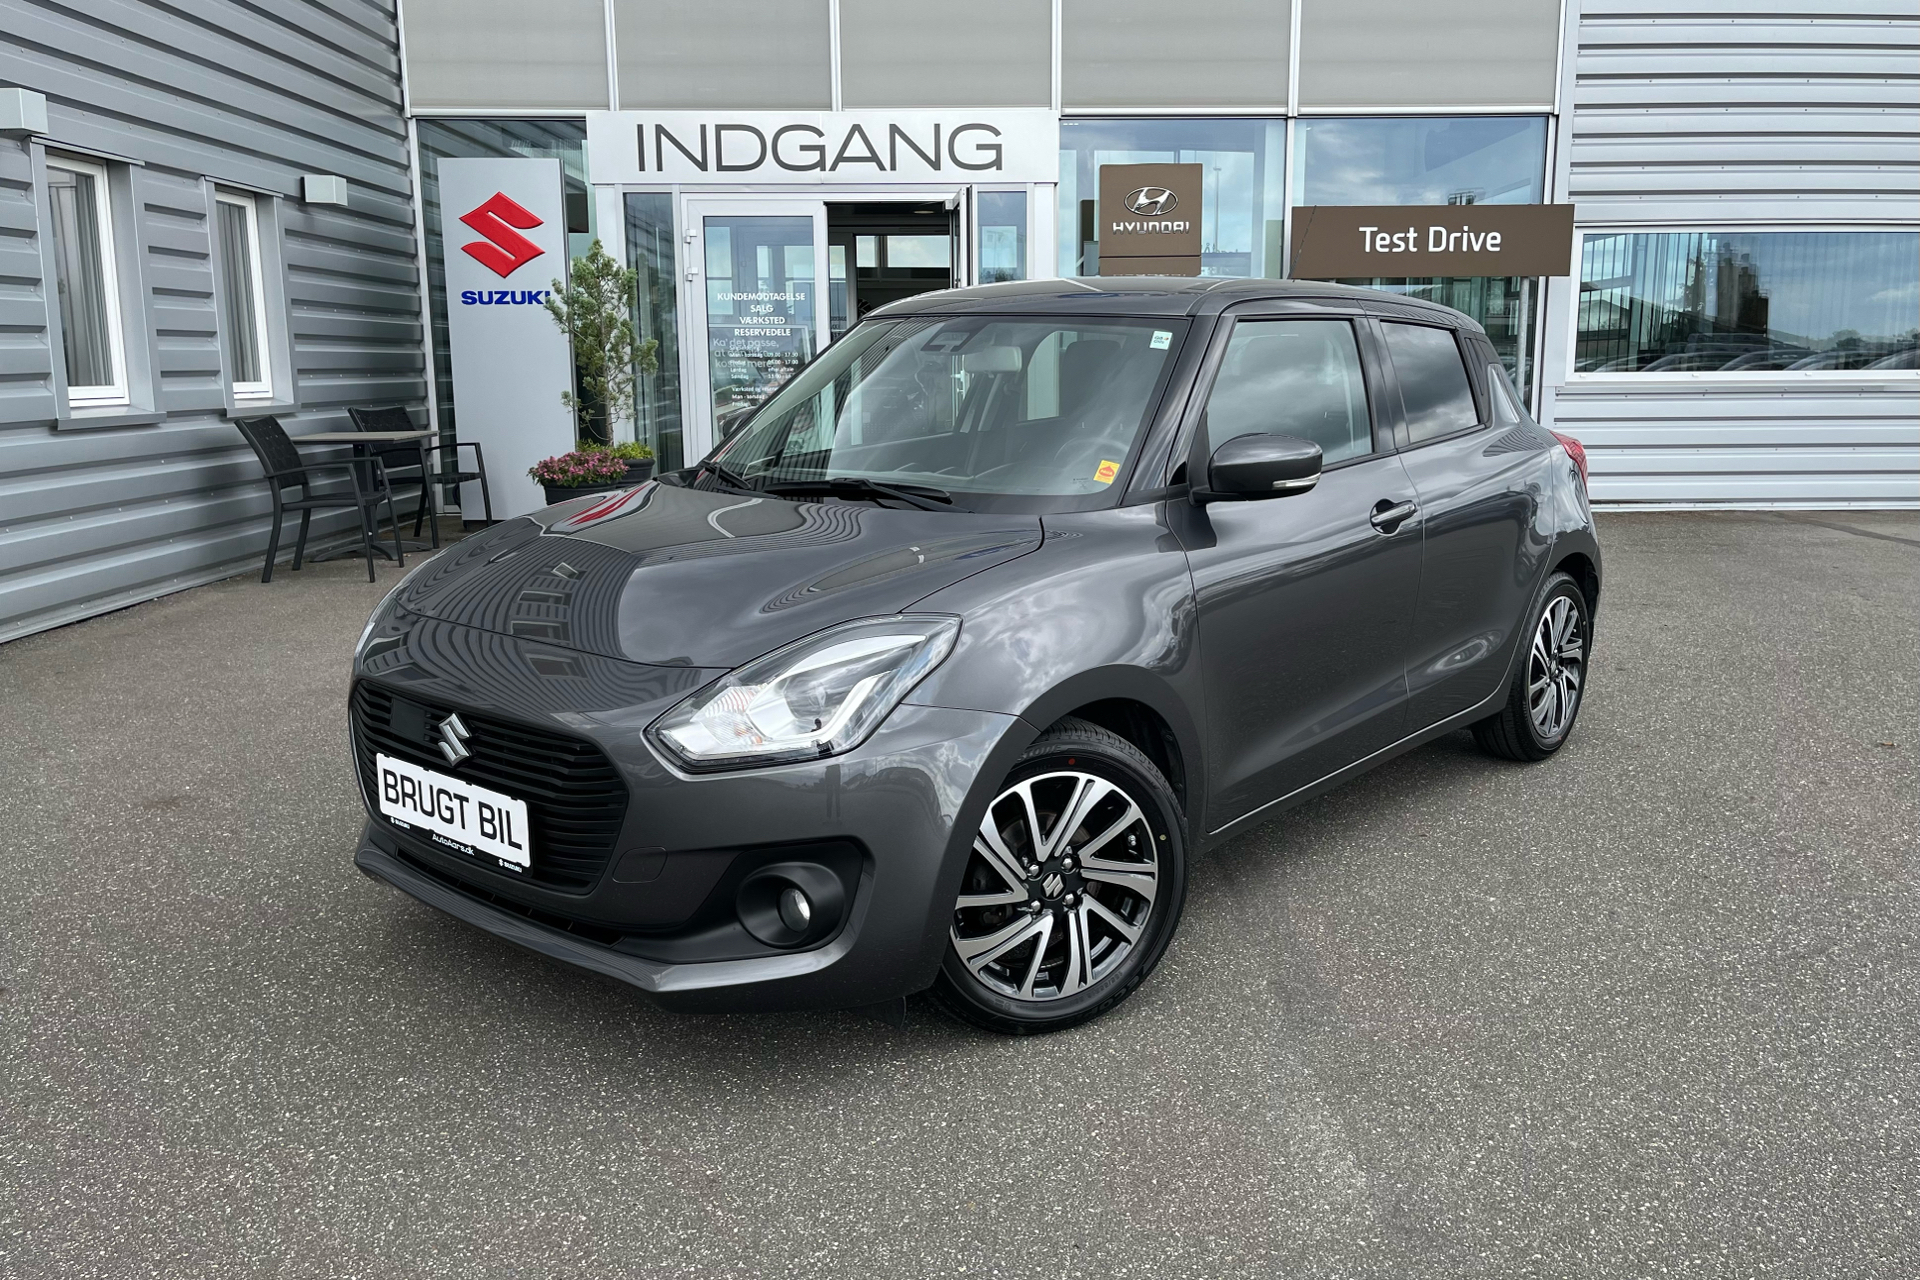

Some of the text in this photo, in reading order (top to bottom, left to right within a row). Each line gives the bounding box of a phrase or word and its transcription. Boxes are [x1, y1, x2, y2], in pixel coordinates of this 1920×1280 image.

[636, 123, 1003, 172] INDGANG
[1112, 221, 1190, 235] HYUNDAI
[1358, 226, 1502, 253] Test Drive
[717, 292, 806, 301] KUNDEMODTAGELSE
[750, 304, 774, 313] SALG
[739, 316, 786, 325] VÆRKSTED
[734, 328, 791, 337] RESERVEDELE
[729, 337, 746, 347] det
[747, 339, 780, 350] passe,
[382, 768, 522, 850] BRUGT BIL
